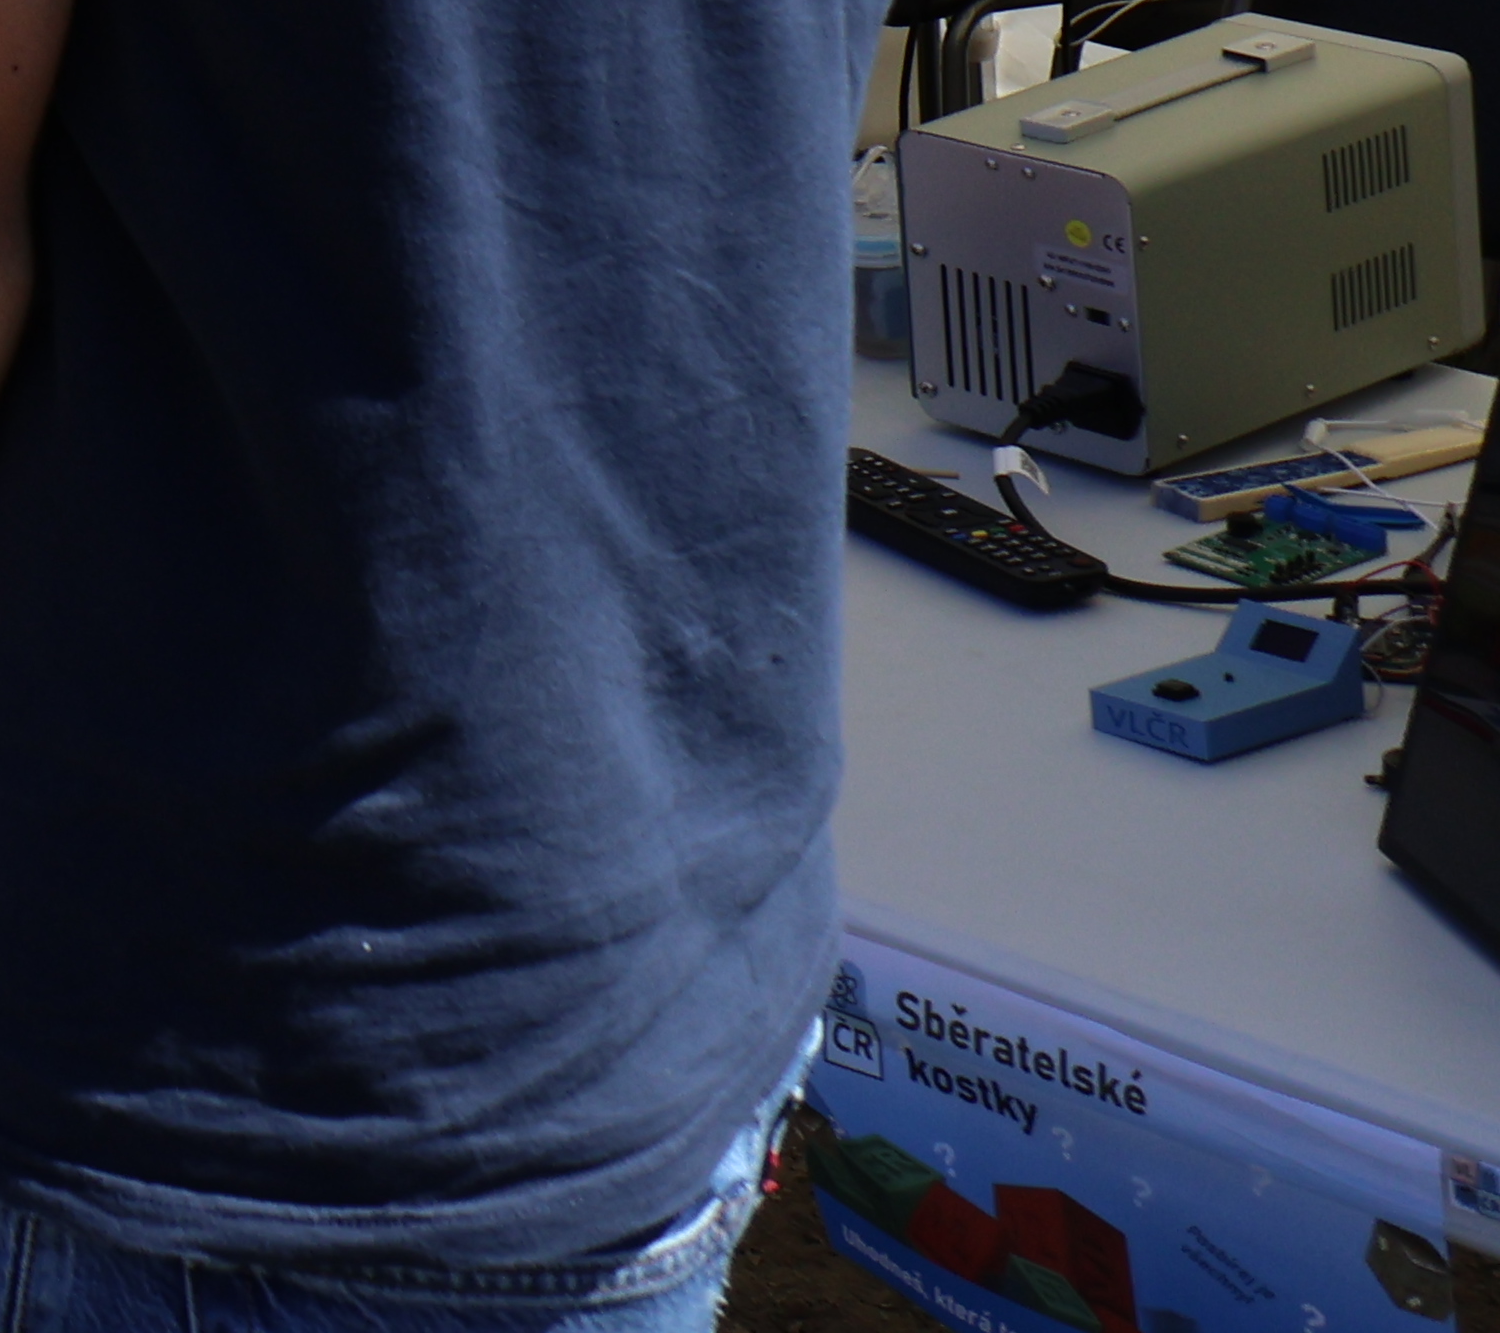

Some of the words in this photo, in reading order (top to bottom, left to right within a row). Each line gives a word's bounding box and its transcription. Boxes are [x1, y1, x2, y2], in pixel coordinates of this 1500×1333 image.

[1106, 705, 1188, 748] VLČR
[833, 1017, 874, 1061] ČR
[895, 990, 1147, 1116] Sběratelské
[905, 1047, 1038, 1136] kostky
